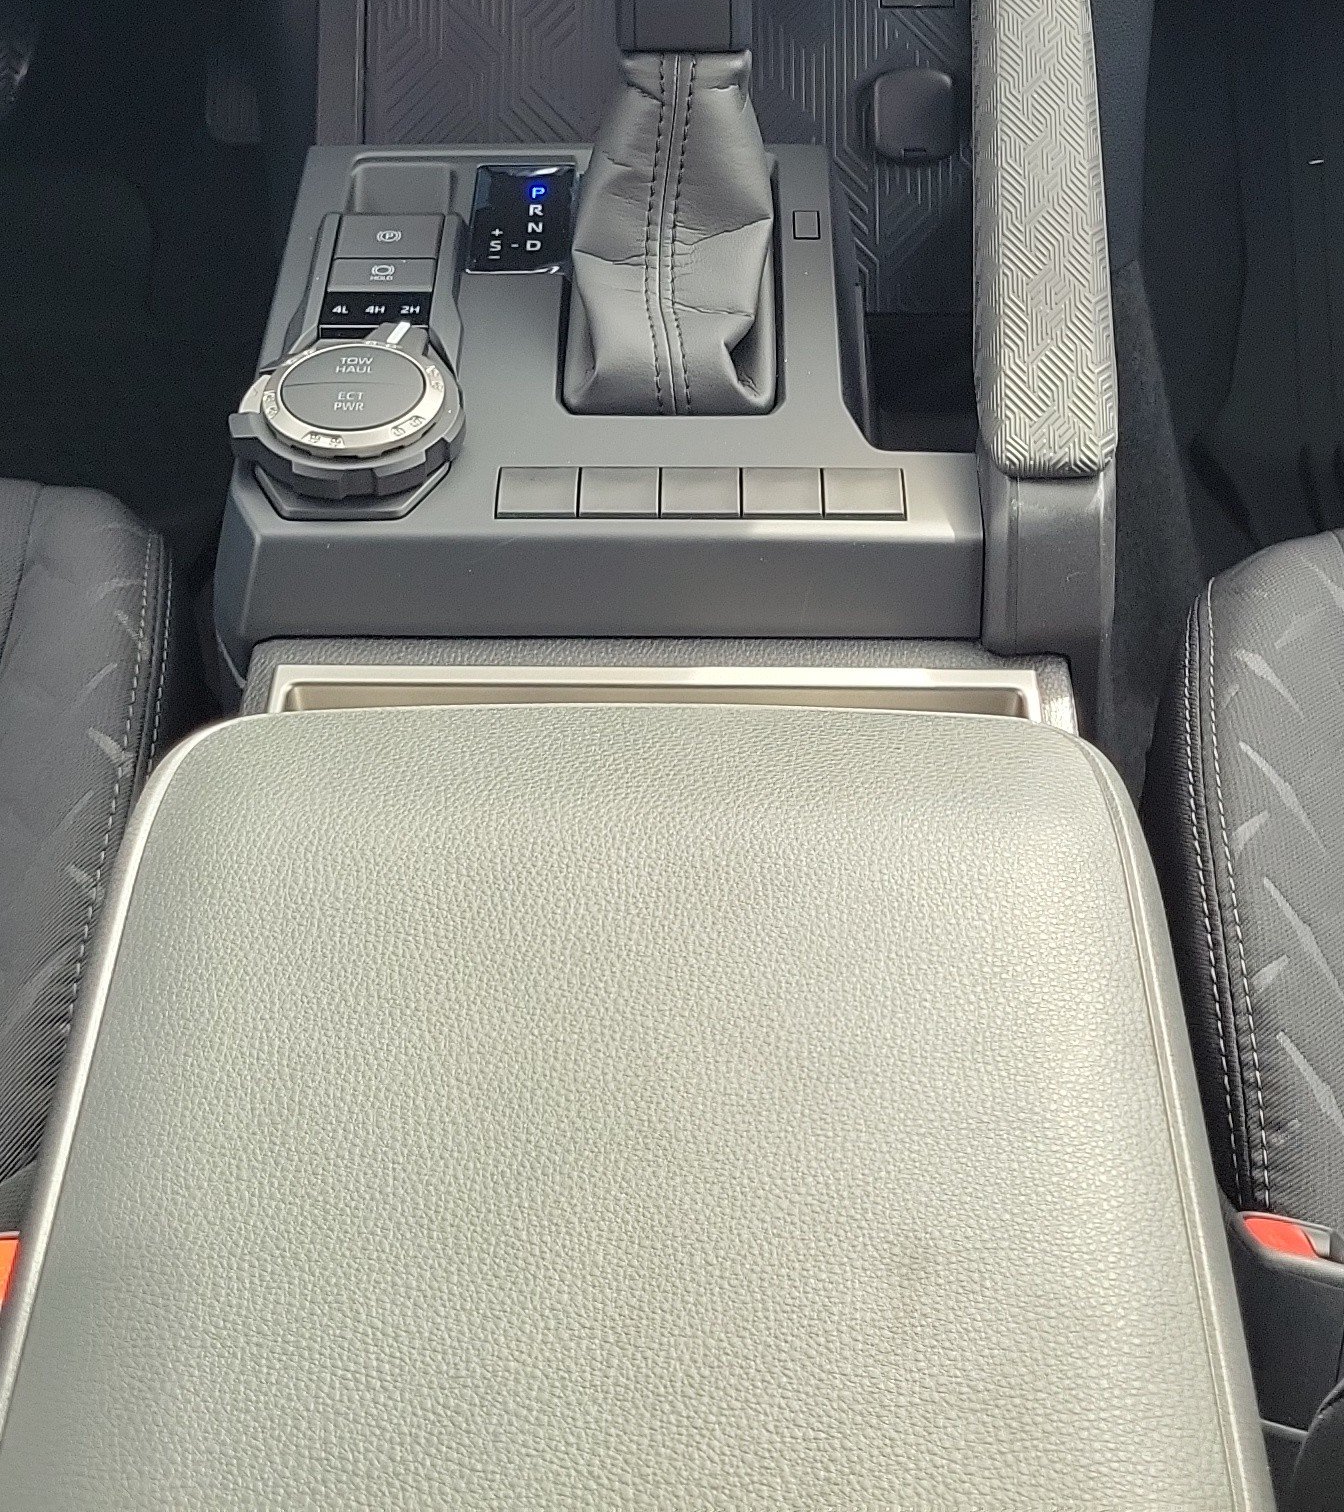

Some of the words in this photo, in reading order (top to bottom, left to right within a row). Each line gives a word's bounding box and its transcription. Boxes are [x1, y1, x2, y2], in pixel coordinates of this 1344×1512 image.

[531, 187, 546, 199] P
[528, 204, 544, 216] R
[527, 222, 543, 233] N
[489, 240, 502, 252] S
[525, 240, 542, 251] D
[332, 305, 349, 314] 4L
[365, 305, 386, 314] 4H
[400, 305, 421, 314] 2H
[340, 357, 374, 365] TOW
[335, 365, 374, 374] HAUL
[338, 391, 364, 400] ECT
[333, 401, 365, 411] PWR
